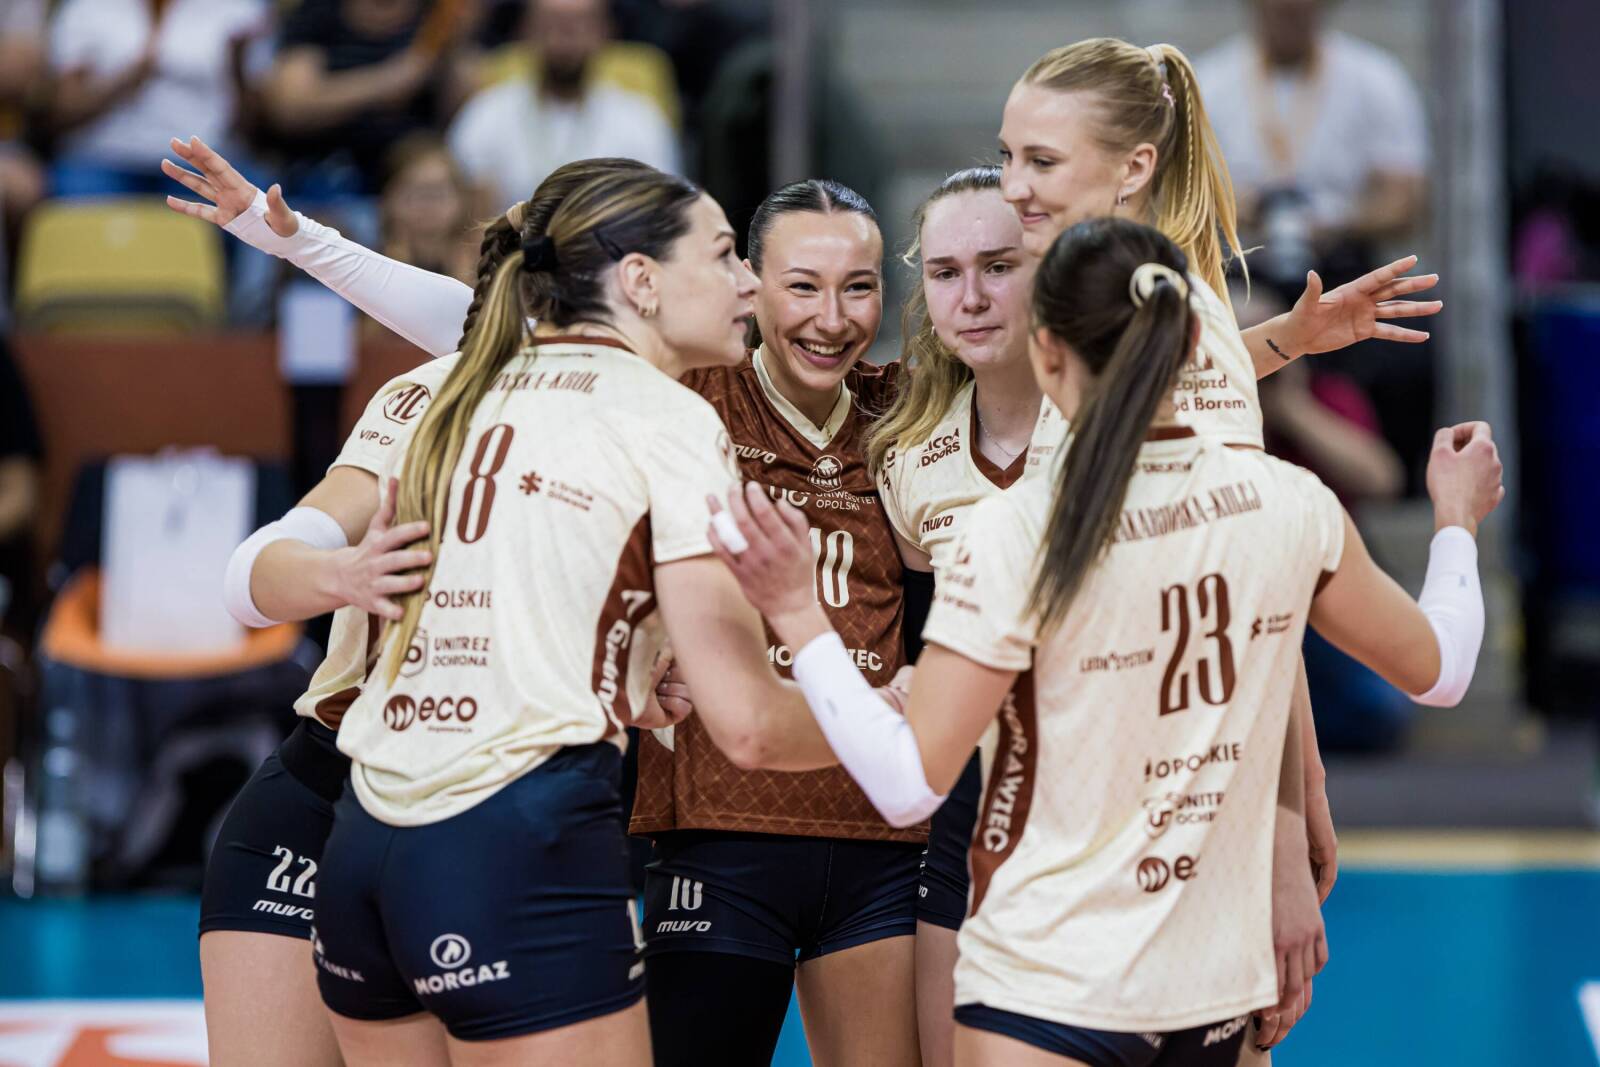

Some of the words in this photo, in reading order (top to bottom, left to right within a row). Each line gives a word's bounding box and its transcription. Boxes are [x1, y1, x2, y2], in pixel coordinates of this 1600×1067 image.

[1194, 397, 1247, 411] Borem
[360, 430, 379, 441] VIP
[440, 424, 514, 544] 8
[816, 499, 861, 512] OPOLSKI
[434, 636, 489, 652] UNITREZ
[1158, 573, 1237, 717] 23
[265, 844, 318, 899] 22
[252, 899, 315, 921] muvo
[656, 920, 712, 933] muvo
[413, 959, 511, 996] MORGAZ
